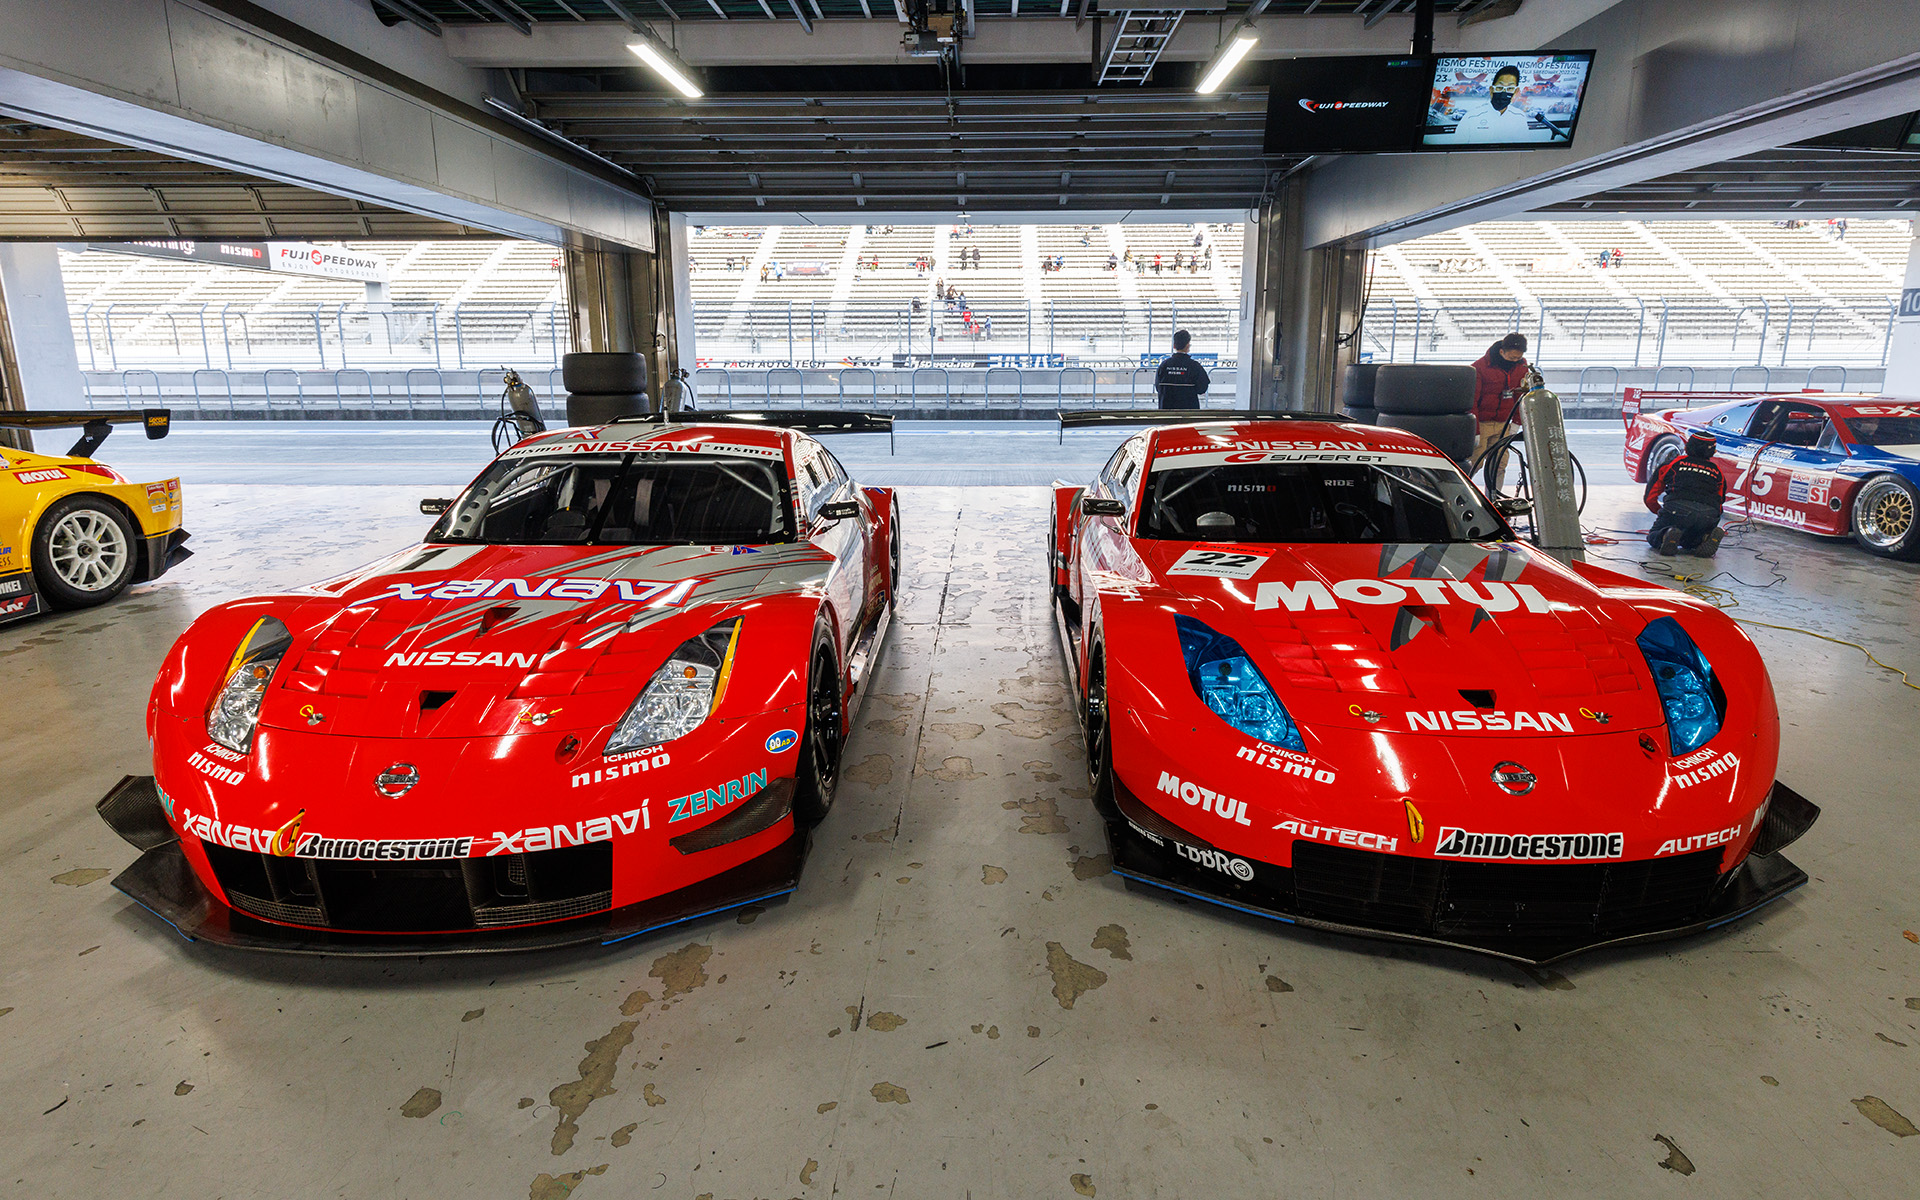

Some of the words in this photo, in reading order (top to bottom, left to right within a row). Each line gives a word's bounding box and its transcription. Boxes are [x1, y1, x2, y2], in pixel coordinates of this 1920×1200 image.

[1517, 61, 1544, 69] NISMO
[1545, 62, 1581, 70] FESTIVAL
[1335, 101, 1389, 110] SPEEDWAY
[221, 244, 262, 258] nismo
[281, 249, 309, 260] FUJI
[311, 249, 377, 269] SPEEDWAY
[723, 360, 755, 368] FACH
[758, 360, 791, 368] AUTO
[795, 360, 826, 368] TECH
[572, 442, 702, 453] NISSAN
[713, 446, 773, 456] nismo
[1161, 444, 1223, 454] nismo
[1236, 441, 1367, 451] NISSAN
[1379, 444, 1436, 454] nismo
[1270, 454, 1351, 462] SUPER
[18, 469, 67, 484] MOTUL
[1680, 461, 1720, 475] NISSAN
[1733, 461, 1778, 496] 75
[1227, 484, 1277, 493] nismo
[1324, 479, 1354, 487] RIDE
[1810, 487, 1828, 504] S1
[1749, 501, 1806, 525] NISSAN
[1184, 552, 1258, 568] 22
[1254, 579, 1566, 614] MOTUL
[384, 651, 538, 668] NISSAN
[1406, 710, 1576, 733] NISSAN
[203, 742, 246, 764] ICHIKOH
[603, 745, 664, 764] ICHIKOH
[1256, 742, 1317, 766] ICHIKOH
[1672, 747, 1718, 771] ICHIKOH
[187, 751, 246, 786] nismo
[572, 753, 672, 788] nismo
[1236, 746, 1336, 785] nismo
[1672, 751, 1740, 790] nismo
[667, 768, 768, 824] ZENRIN
[1156, 771, 1252, 826] MOTUL
[295, 832, 475, 861] BRIDGESTONE
[1272, 820, 1399, 852] AUTECH
[1434, 826, 1624, 859] BRIDGESTONE
[1654, 824, 1742, 857] AUTECH
